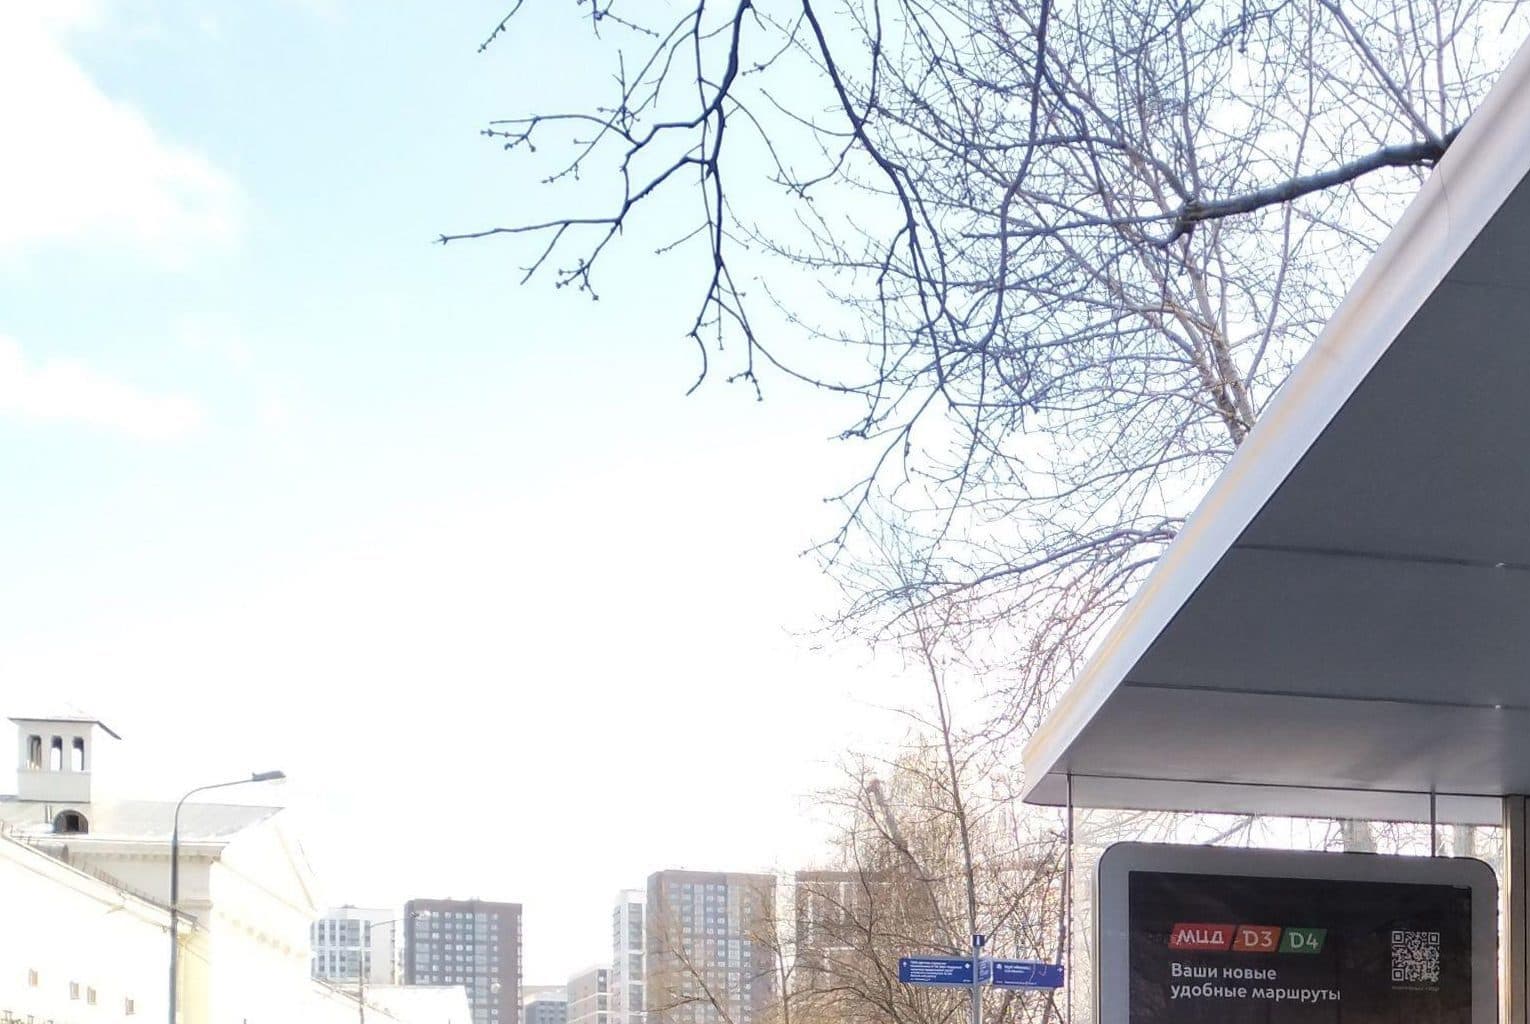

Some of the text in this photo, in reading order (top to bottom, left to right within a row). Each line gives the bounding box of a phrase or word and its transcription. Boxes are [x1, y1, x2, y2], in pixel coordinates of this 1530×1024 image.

[1176, 929, 1319, 949] МЦД D3 D4
[1171, 962, 1277, 980] Ваши новые
[1170, 983, 1341, 1002] удобные маршруты
